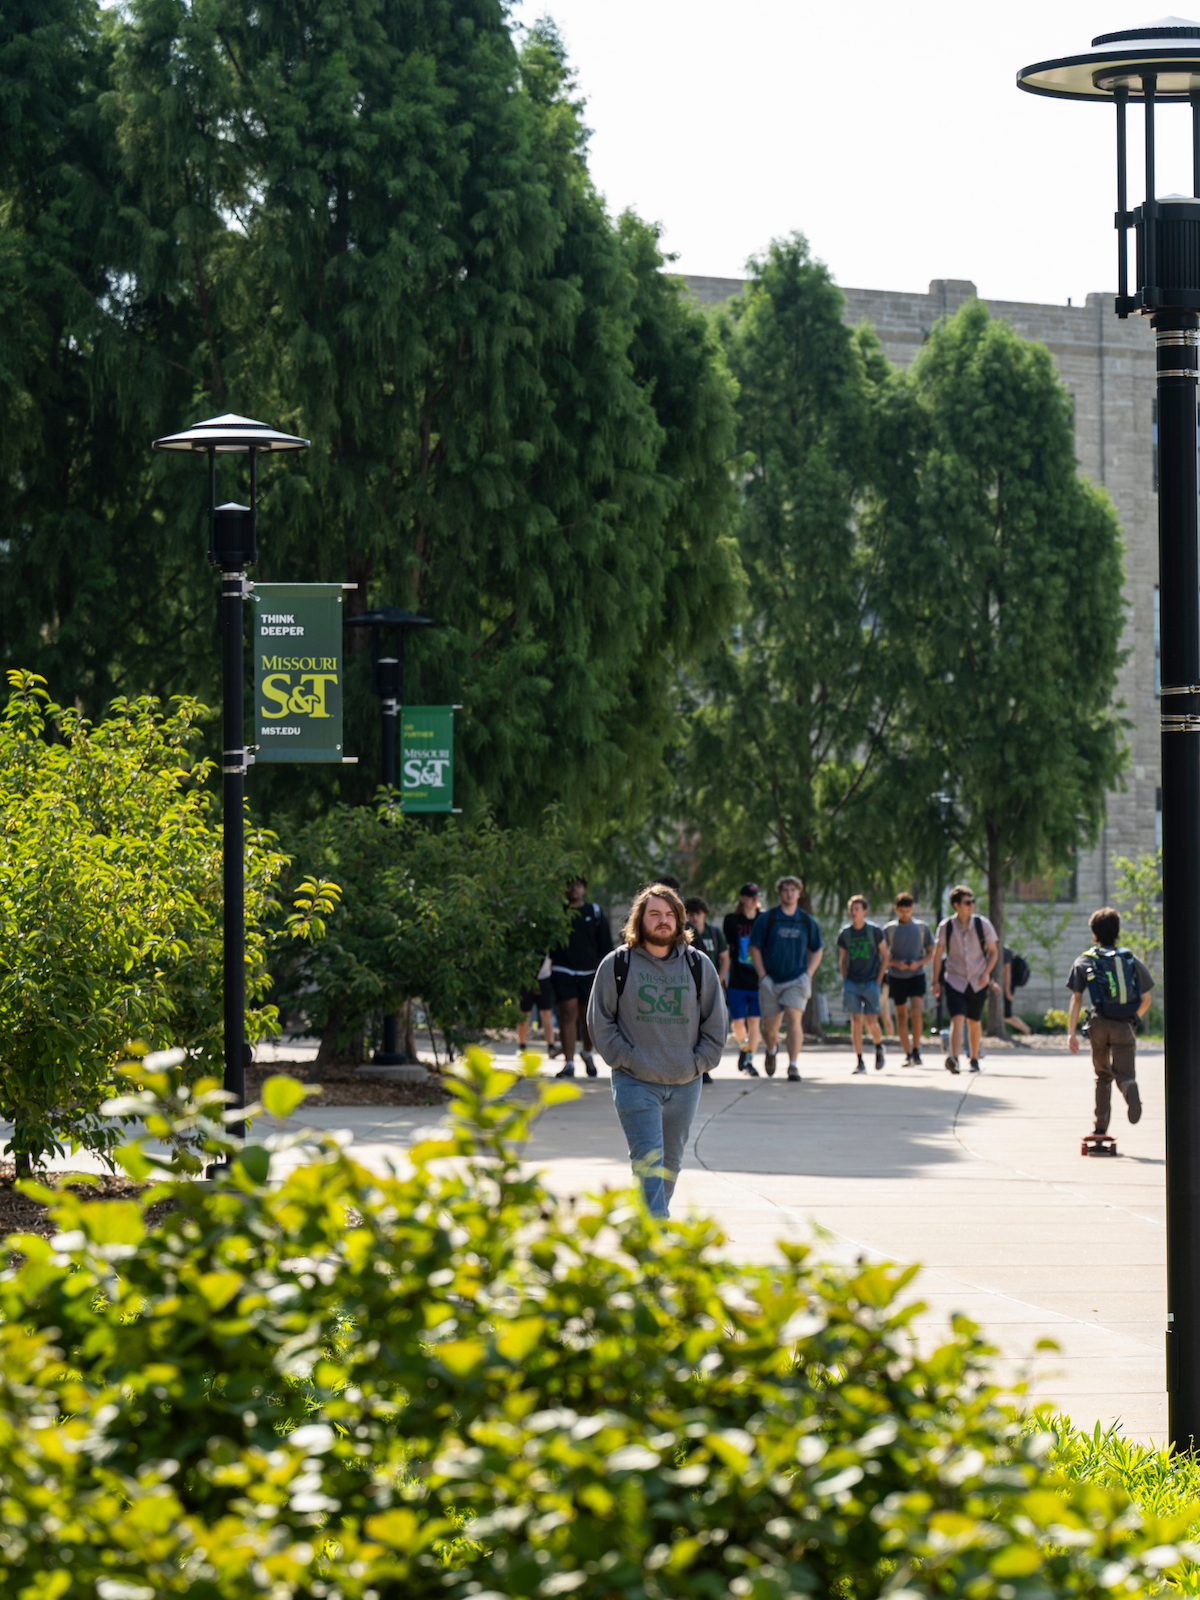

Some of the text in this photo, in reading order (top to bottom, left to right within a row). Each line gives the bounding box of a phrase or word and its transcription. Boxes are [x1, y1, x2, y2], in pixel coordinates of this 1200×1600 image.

[260, 614, 295, 624] THINK
[260, 626, 304, 636] DEEPER
[261, 655, 338, 671] MISSOURI
[261, 673, 338, 719] S&T
[261, 726, 301, 735] MST.EDU
[403, 759, 450, 788] S&T
[638, 971, 690, 985] MISSOURI
[637, 984, 690, 1016] S&T
